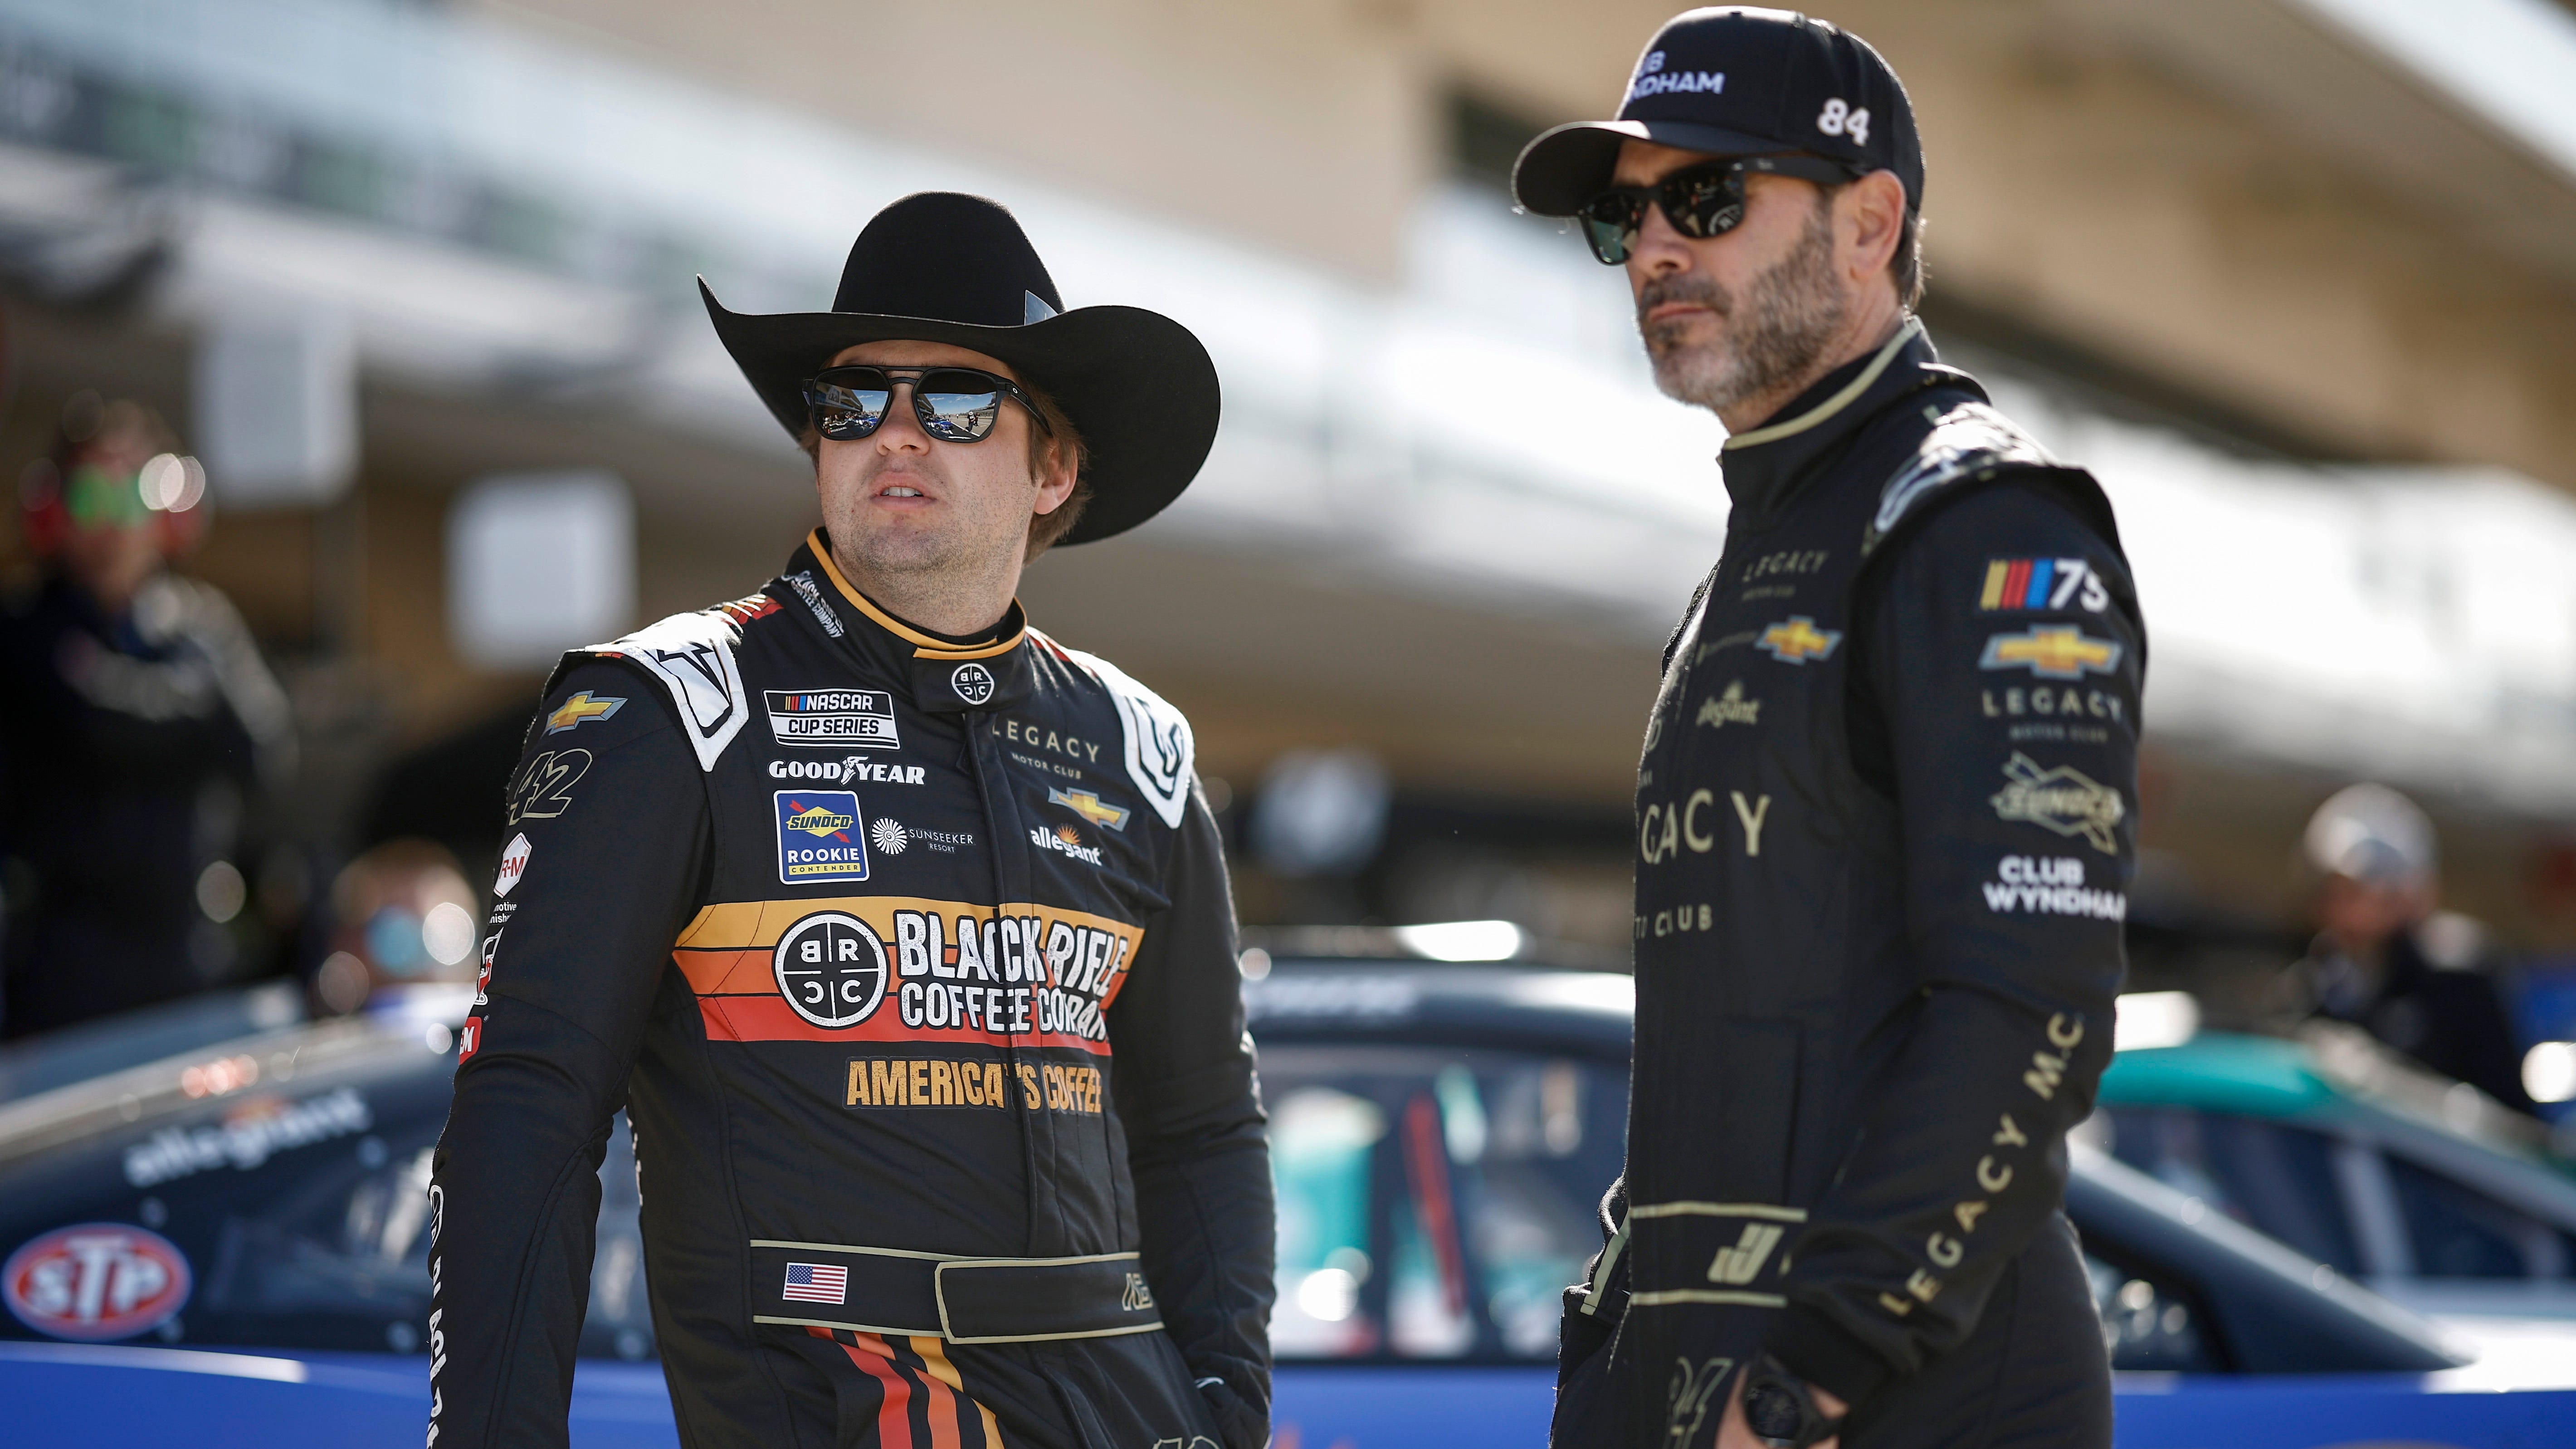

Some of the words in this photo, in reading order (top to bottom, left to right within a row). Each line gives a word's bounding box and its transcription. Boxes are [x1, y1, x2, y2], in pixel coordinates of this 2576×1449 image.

[1816, 97, 1871, 147] 84
[811, 602, 842, 638] COMPANY
[806, 694, 873, 711] NASCAR
[1981, 686, 2122, 722] LEGACY
[788, 719, 820, 734] CUP
[823, 719, 879, 734] SERIES
[992, 720, 1099, 763] LEGACY
[1012, 752, 1048, 770] MOTOR
[1054, 765, 1082, 780] CLUB
[509, 748, 592, 826] 42
[790, 817, 850, 828] SUNOCO
[908, 829, 974, 844] SUNSEEKER
[788, 848, 859, 863] ROOKIE
[929, 843, 955, 853] RESORT
[501, 856, 525, 878] R-M
[1998, 855, 2084, 886] CLUB
[896, 912, 1046, 983] BLACK
[1046, 923, 1128, 997] RIFLE
[902, 982, 1030, 1032] COFFEE
[847, 1060, 1041, 1110] AMERICA'S
[1043, 1065, 1102, 1113] COFFEE
[1879, 1113, 2028, 1317] LEGACY
[28, 1235, 170, 1327] STP
